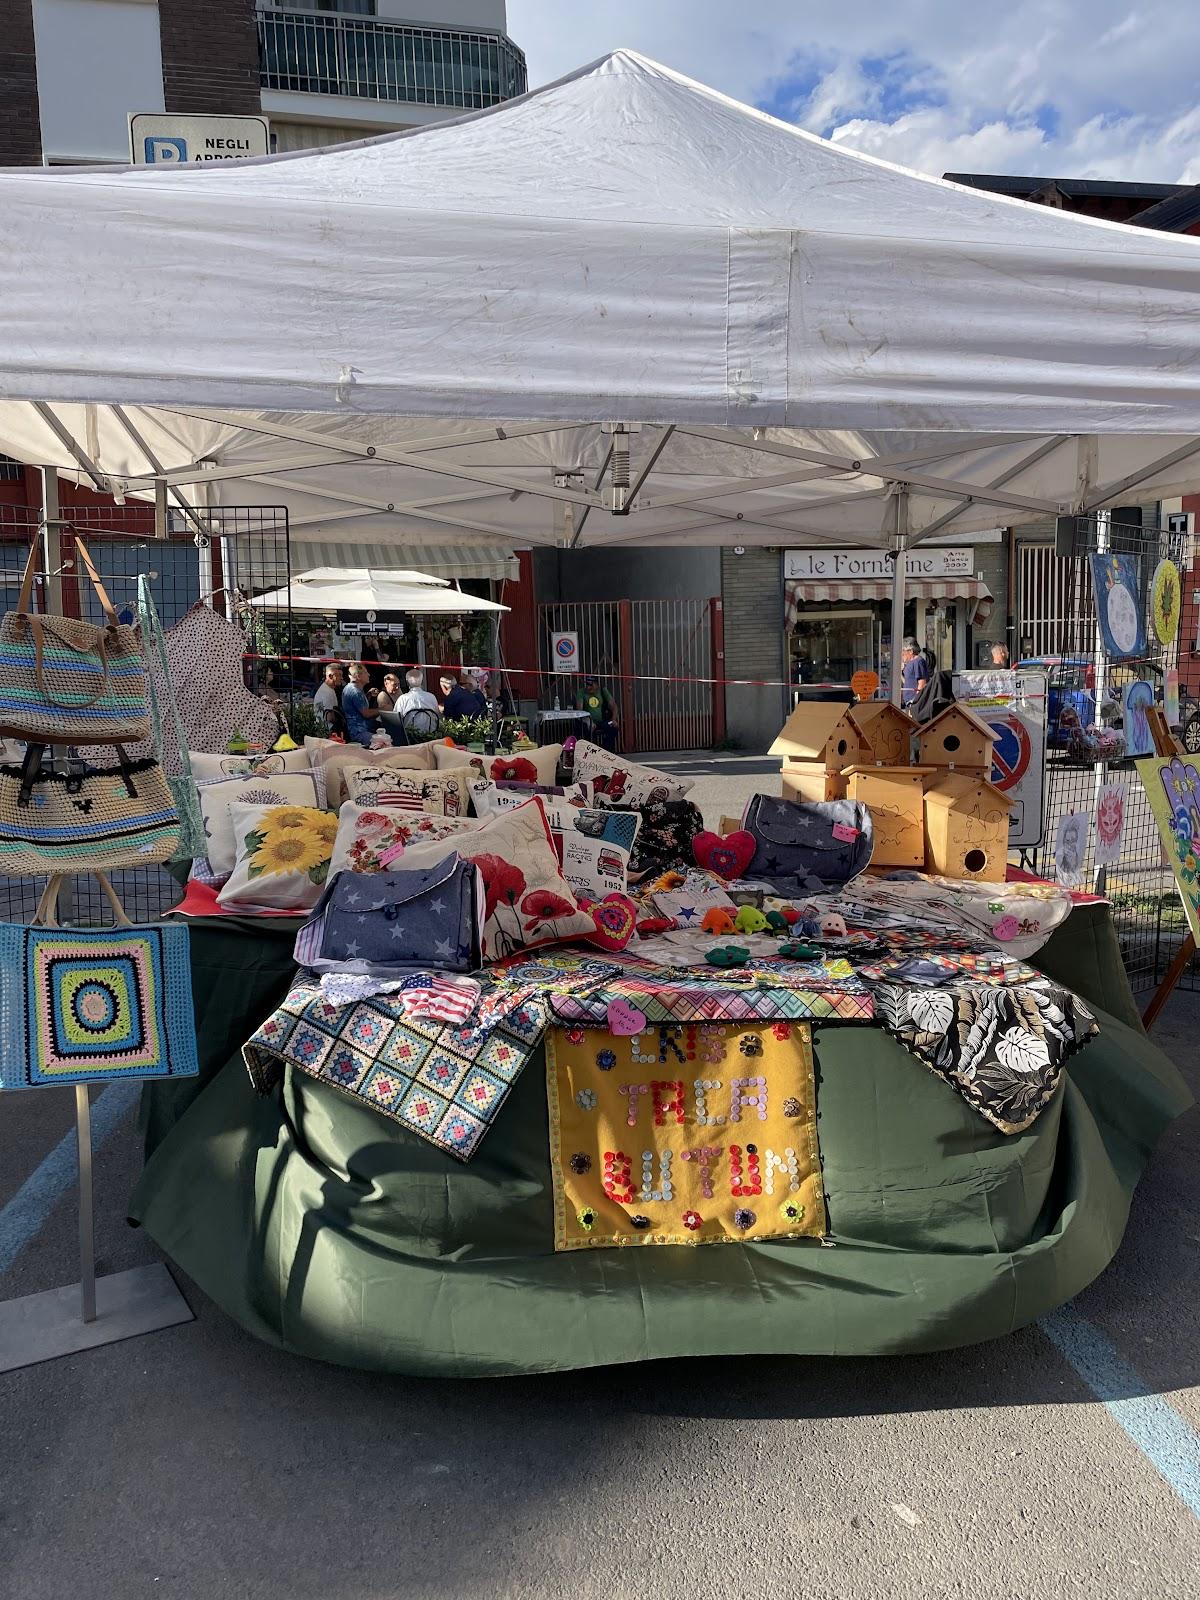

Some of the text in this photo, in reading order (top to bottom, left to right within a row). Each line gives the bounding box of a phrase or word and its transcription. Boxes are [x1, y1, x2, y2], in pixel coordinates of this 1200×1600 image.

[205, 138, 249, 150] NEGLI
[808, 553, 934, 575] le Fornaine
[566, 852, 593, 862] RACING
[604, 880, 622, 892] 1952
[618, 1076, 769, 1127] TACA
